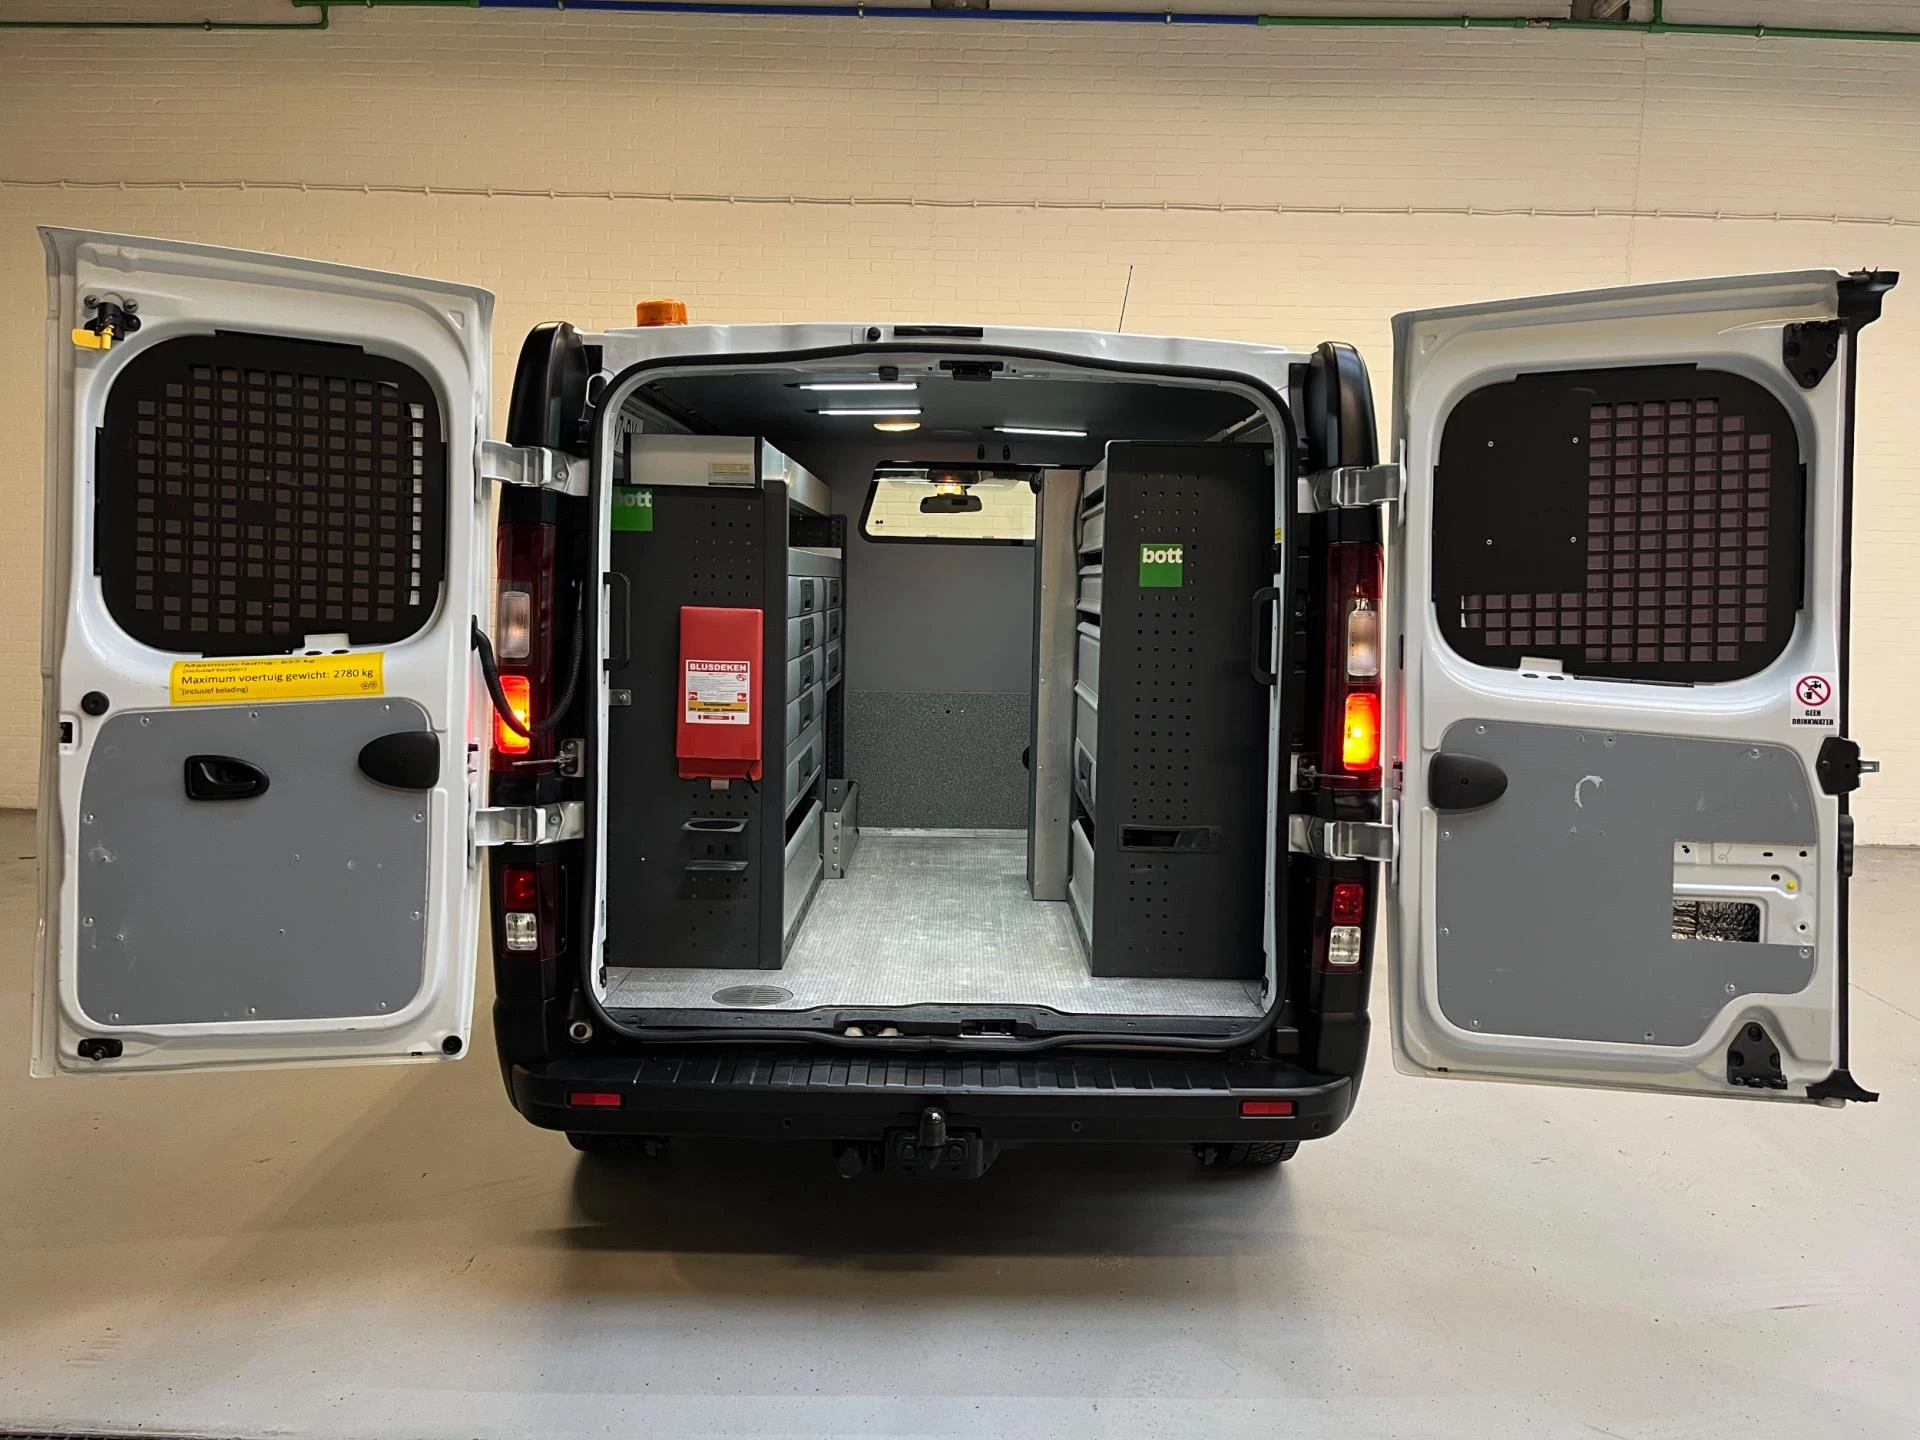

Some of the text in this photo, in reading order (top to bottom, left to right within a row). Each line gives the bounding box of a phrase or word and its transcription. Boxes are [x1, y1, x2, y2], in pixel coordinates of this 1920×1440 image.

[1142, 547, 1183, 564] bott
[689, 663, 747, 671] BLUSDEKEN
[181, 668, 374, 684] Maximum voertuig gewicht: 2780 kg
